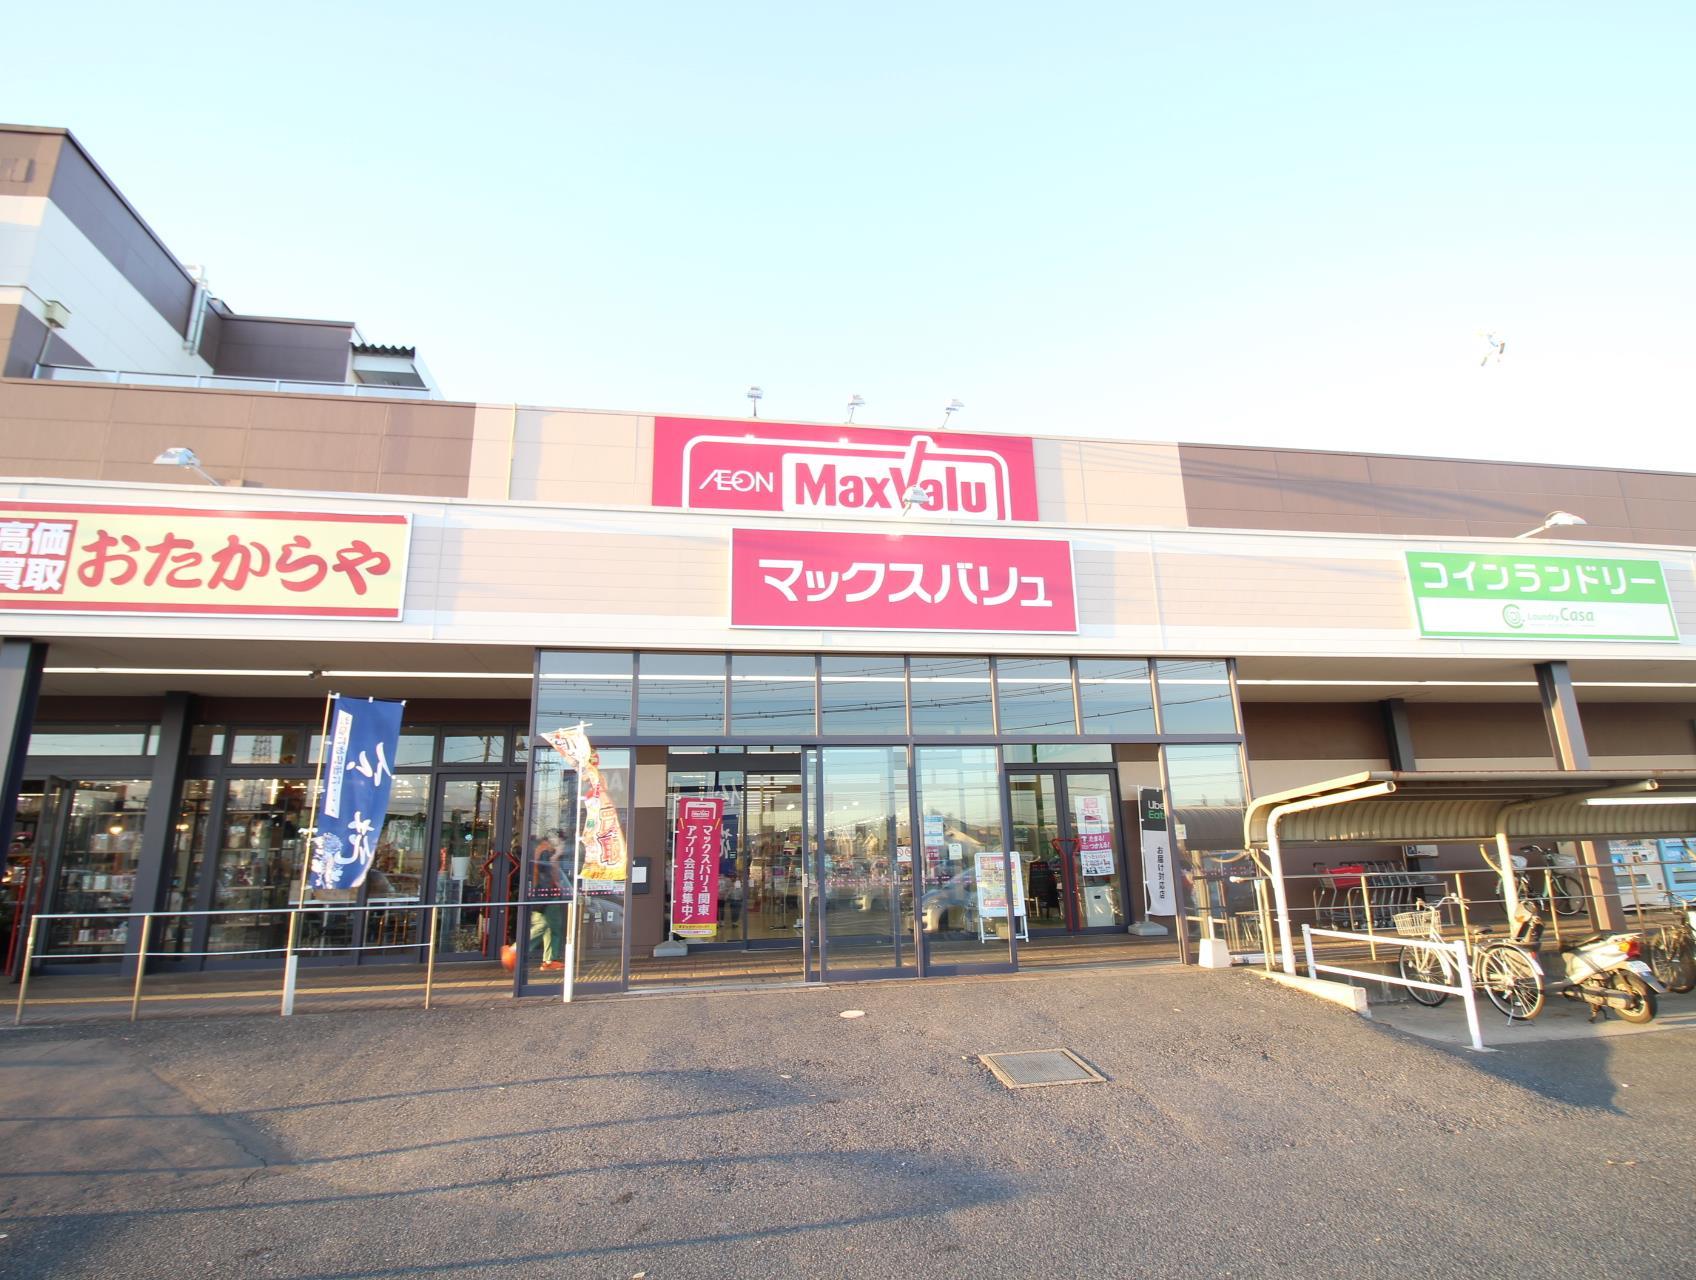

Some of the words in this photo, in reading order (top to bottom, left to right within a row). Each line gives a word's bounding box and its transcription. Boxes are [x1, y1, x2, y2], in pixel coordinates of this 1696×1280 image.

[795, 441, 987, 512] MaxValu
[0, 521, 74, 556] 高価
[0, 556, 67, 592] 買取
[78, 530, 391, 595] おたからや
[1420, 561, 1656, 595] コインランドリー
[758, 559, 1053, 608] マックスバリュ
[1560, 607, 1595, 621] Casa
[1147, 799, 1164, 810] Ube
[1148, 810, 1165, 820] Eat
[697, 825, 713, 916] マックスバリュ関東
